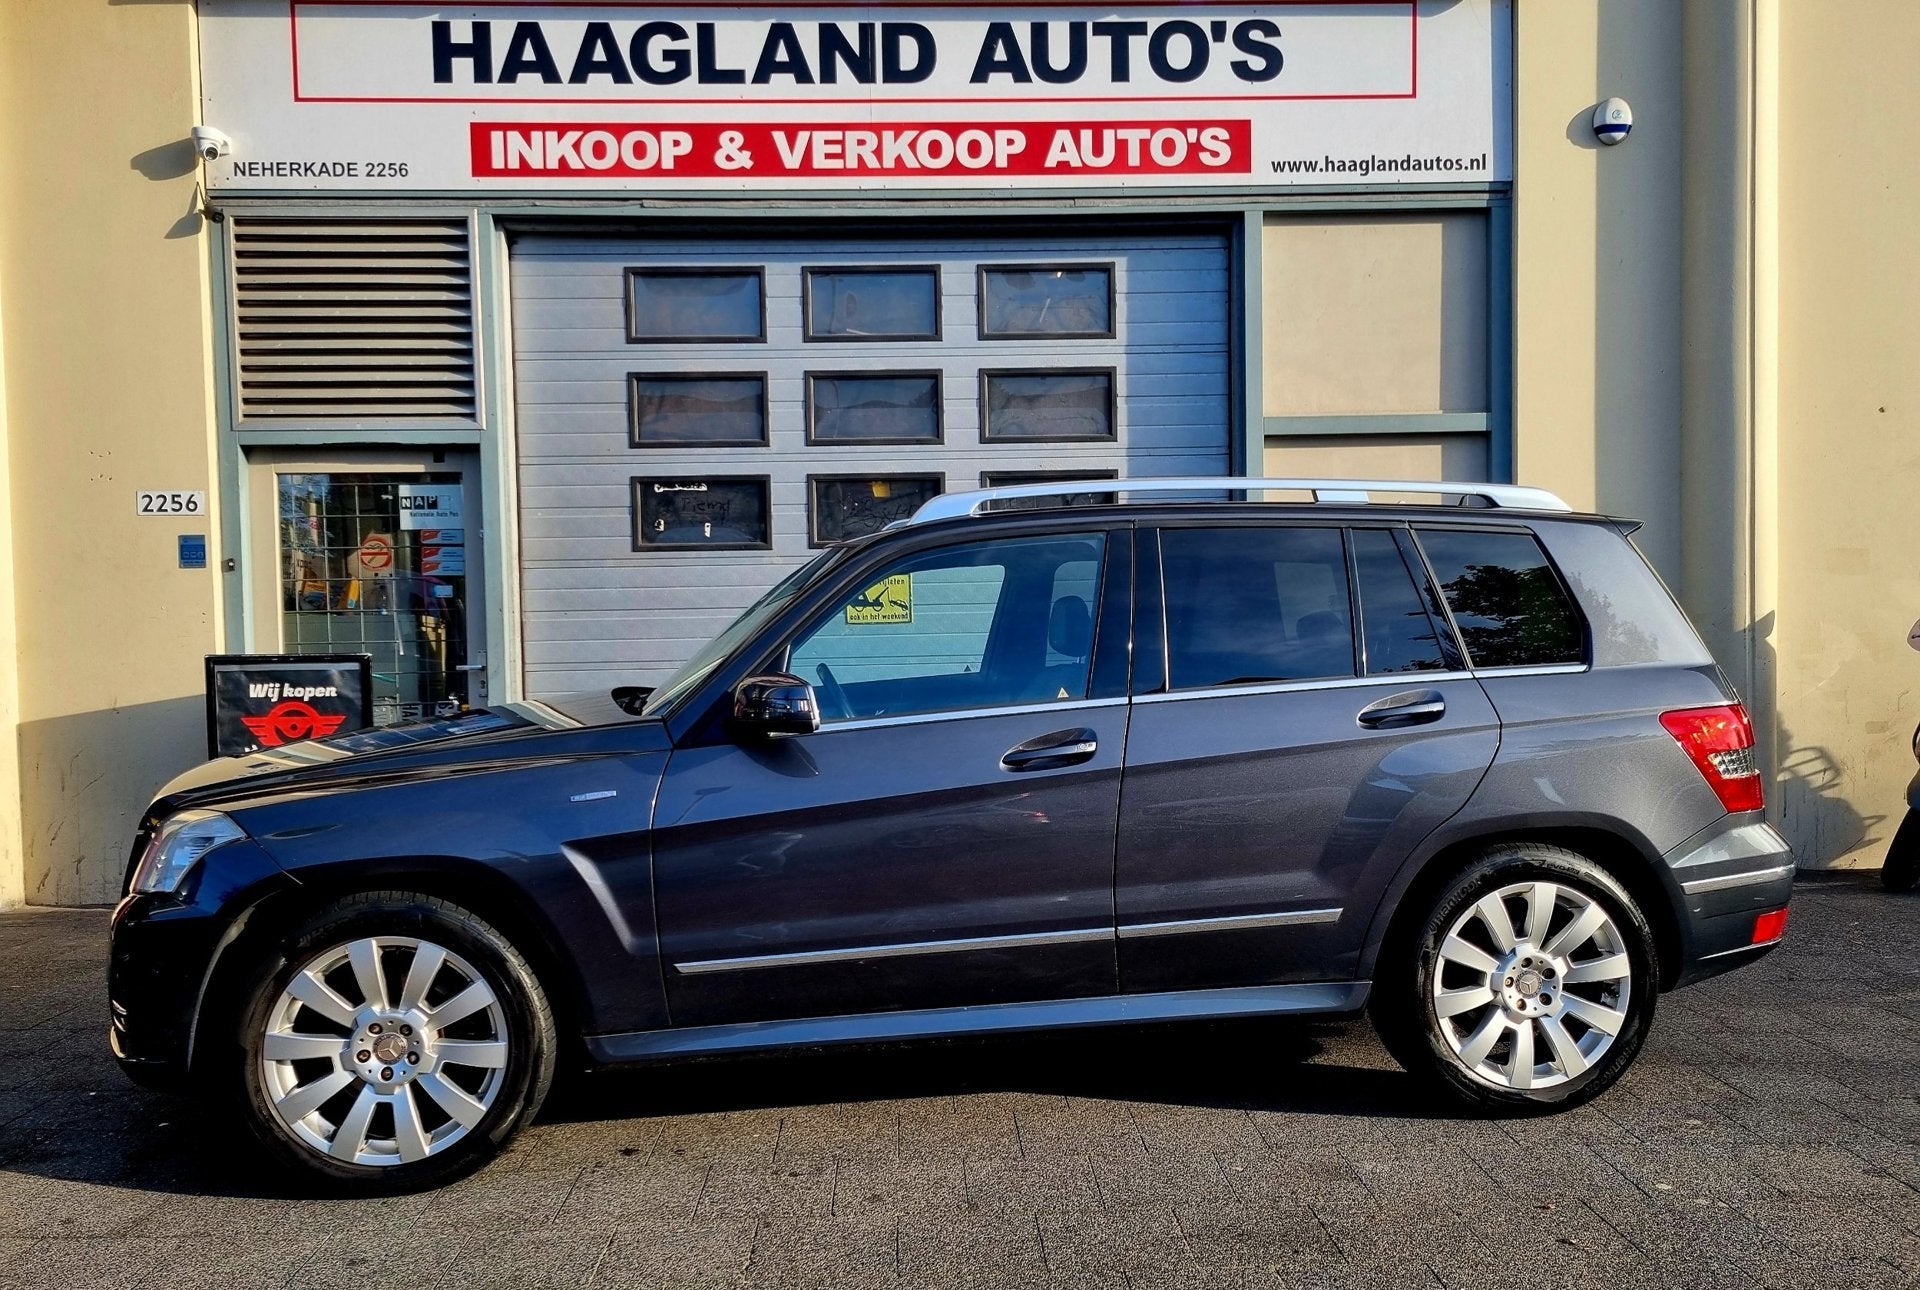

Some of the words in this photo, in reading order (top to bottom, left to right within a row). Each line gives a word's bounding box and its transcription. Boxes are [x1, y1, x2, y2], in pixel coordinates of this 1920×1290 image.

[432, 20, 936, 85] HAAGLAND
[969, 19, 1284, 84] AUTO'S
[490, 130, 693, 170] INKOOP
[714, 130, 754, 170] &
[771, 129, 1027, 170] VERKOOP
[1044, 126, 1232, 168] AUTO'S
[233, 161, 359, 178] NEHERKADE
[365, 162, 409, 178] 2256
[1271, 153, 1487, 177] www.haaglandautos.nl
[141, 494, 198, 512] 2256
[401, 496, 437, 508] NAP
[250, 683, 280, 702] Wij
[283, 683, 337, 702] kopen
